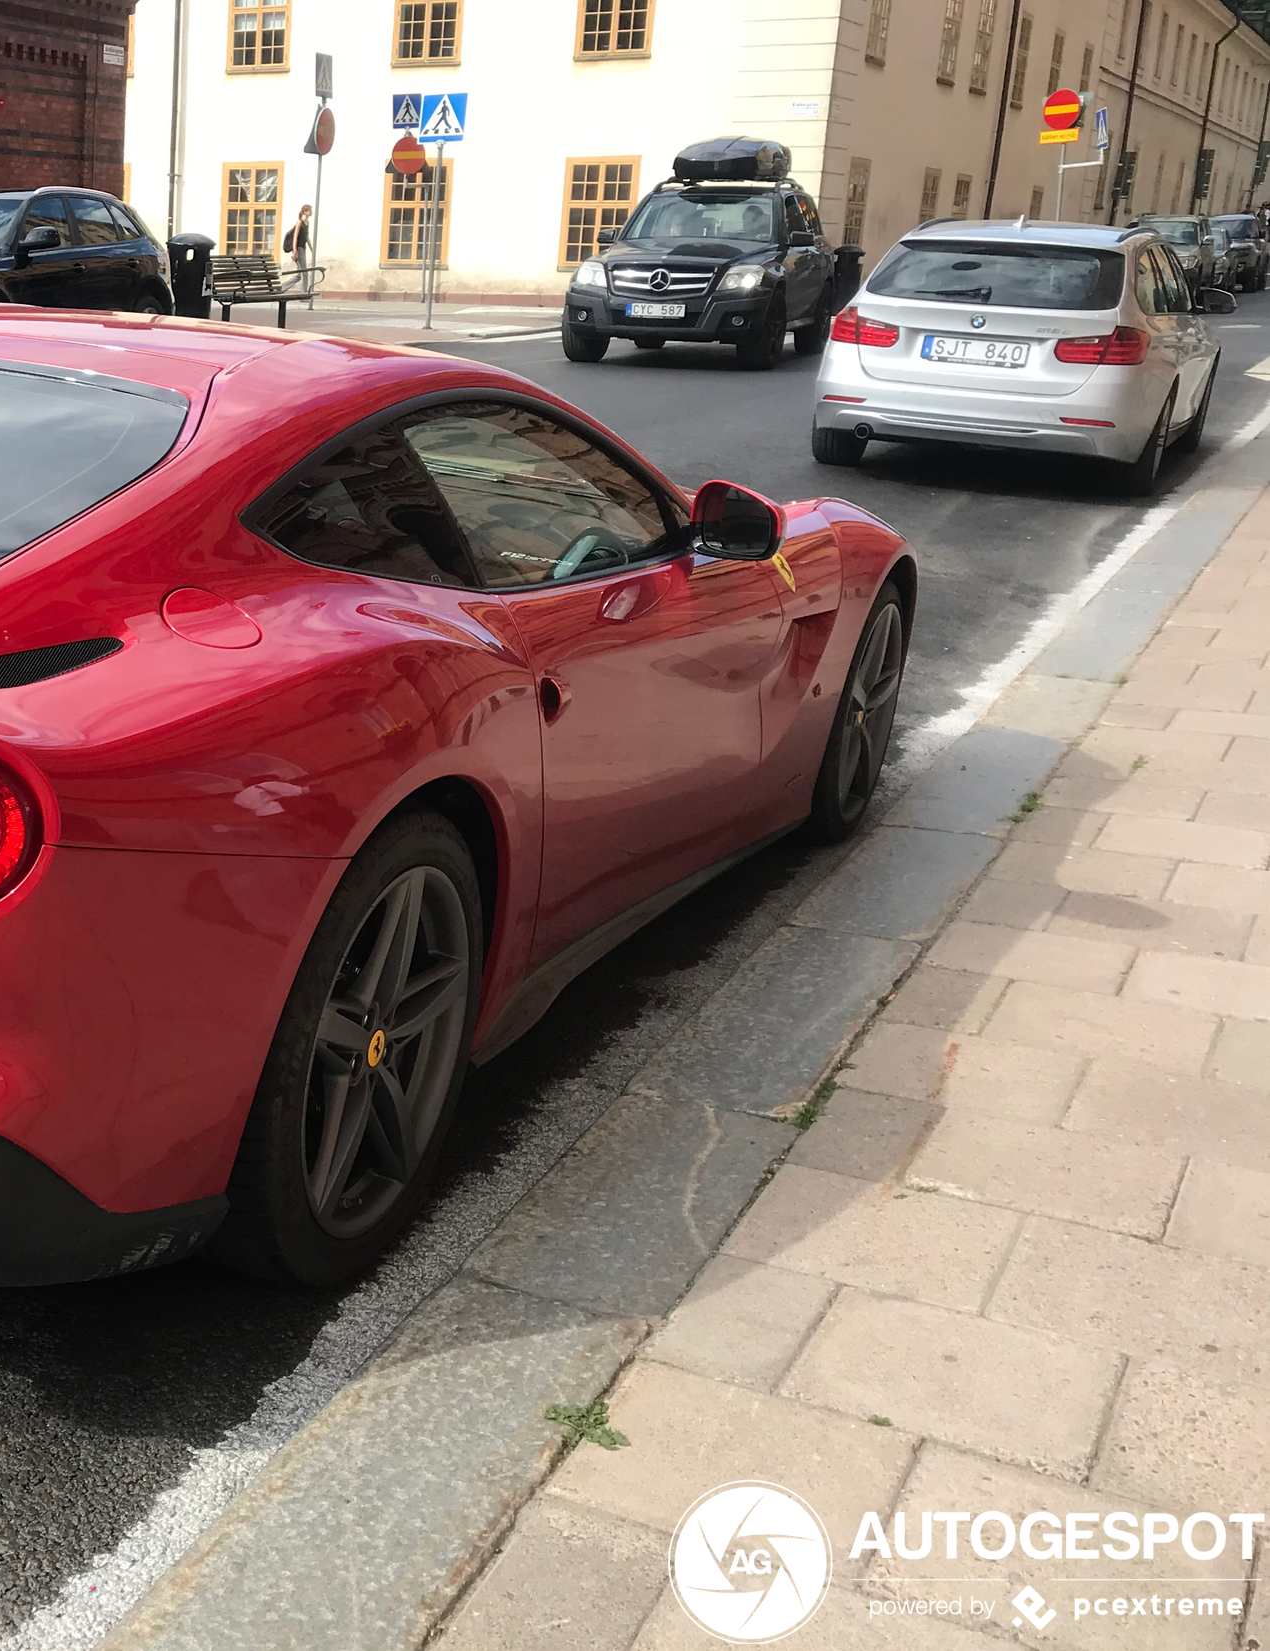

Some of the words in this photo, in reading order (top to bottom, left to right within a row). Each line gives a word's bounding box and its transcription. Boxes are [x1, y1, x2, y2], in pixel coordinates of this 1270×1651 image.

[633, 304, 653, 315] CYC
[661, 305, 683, 315] 587
[934, 339, 972, 357] SJT
[985, 343, 1023, 361] 840
